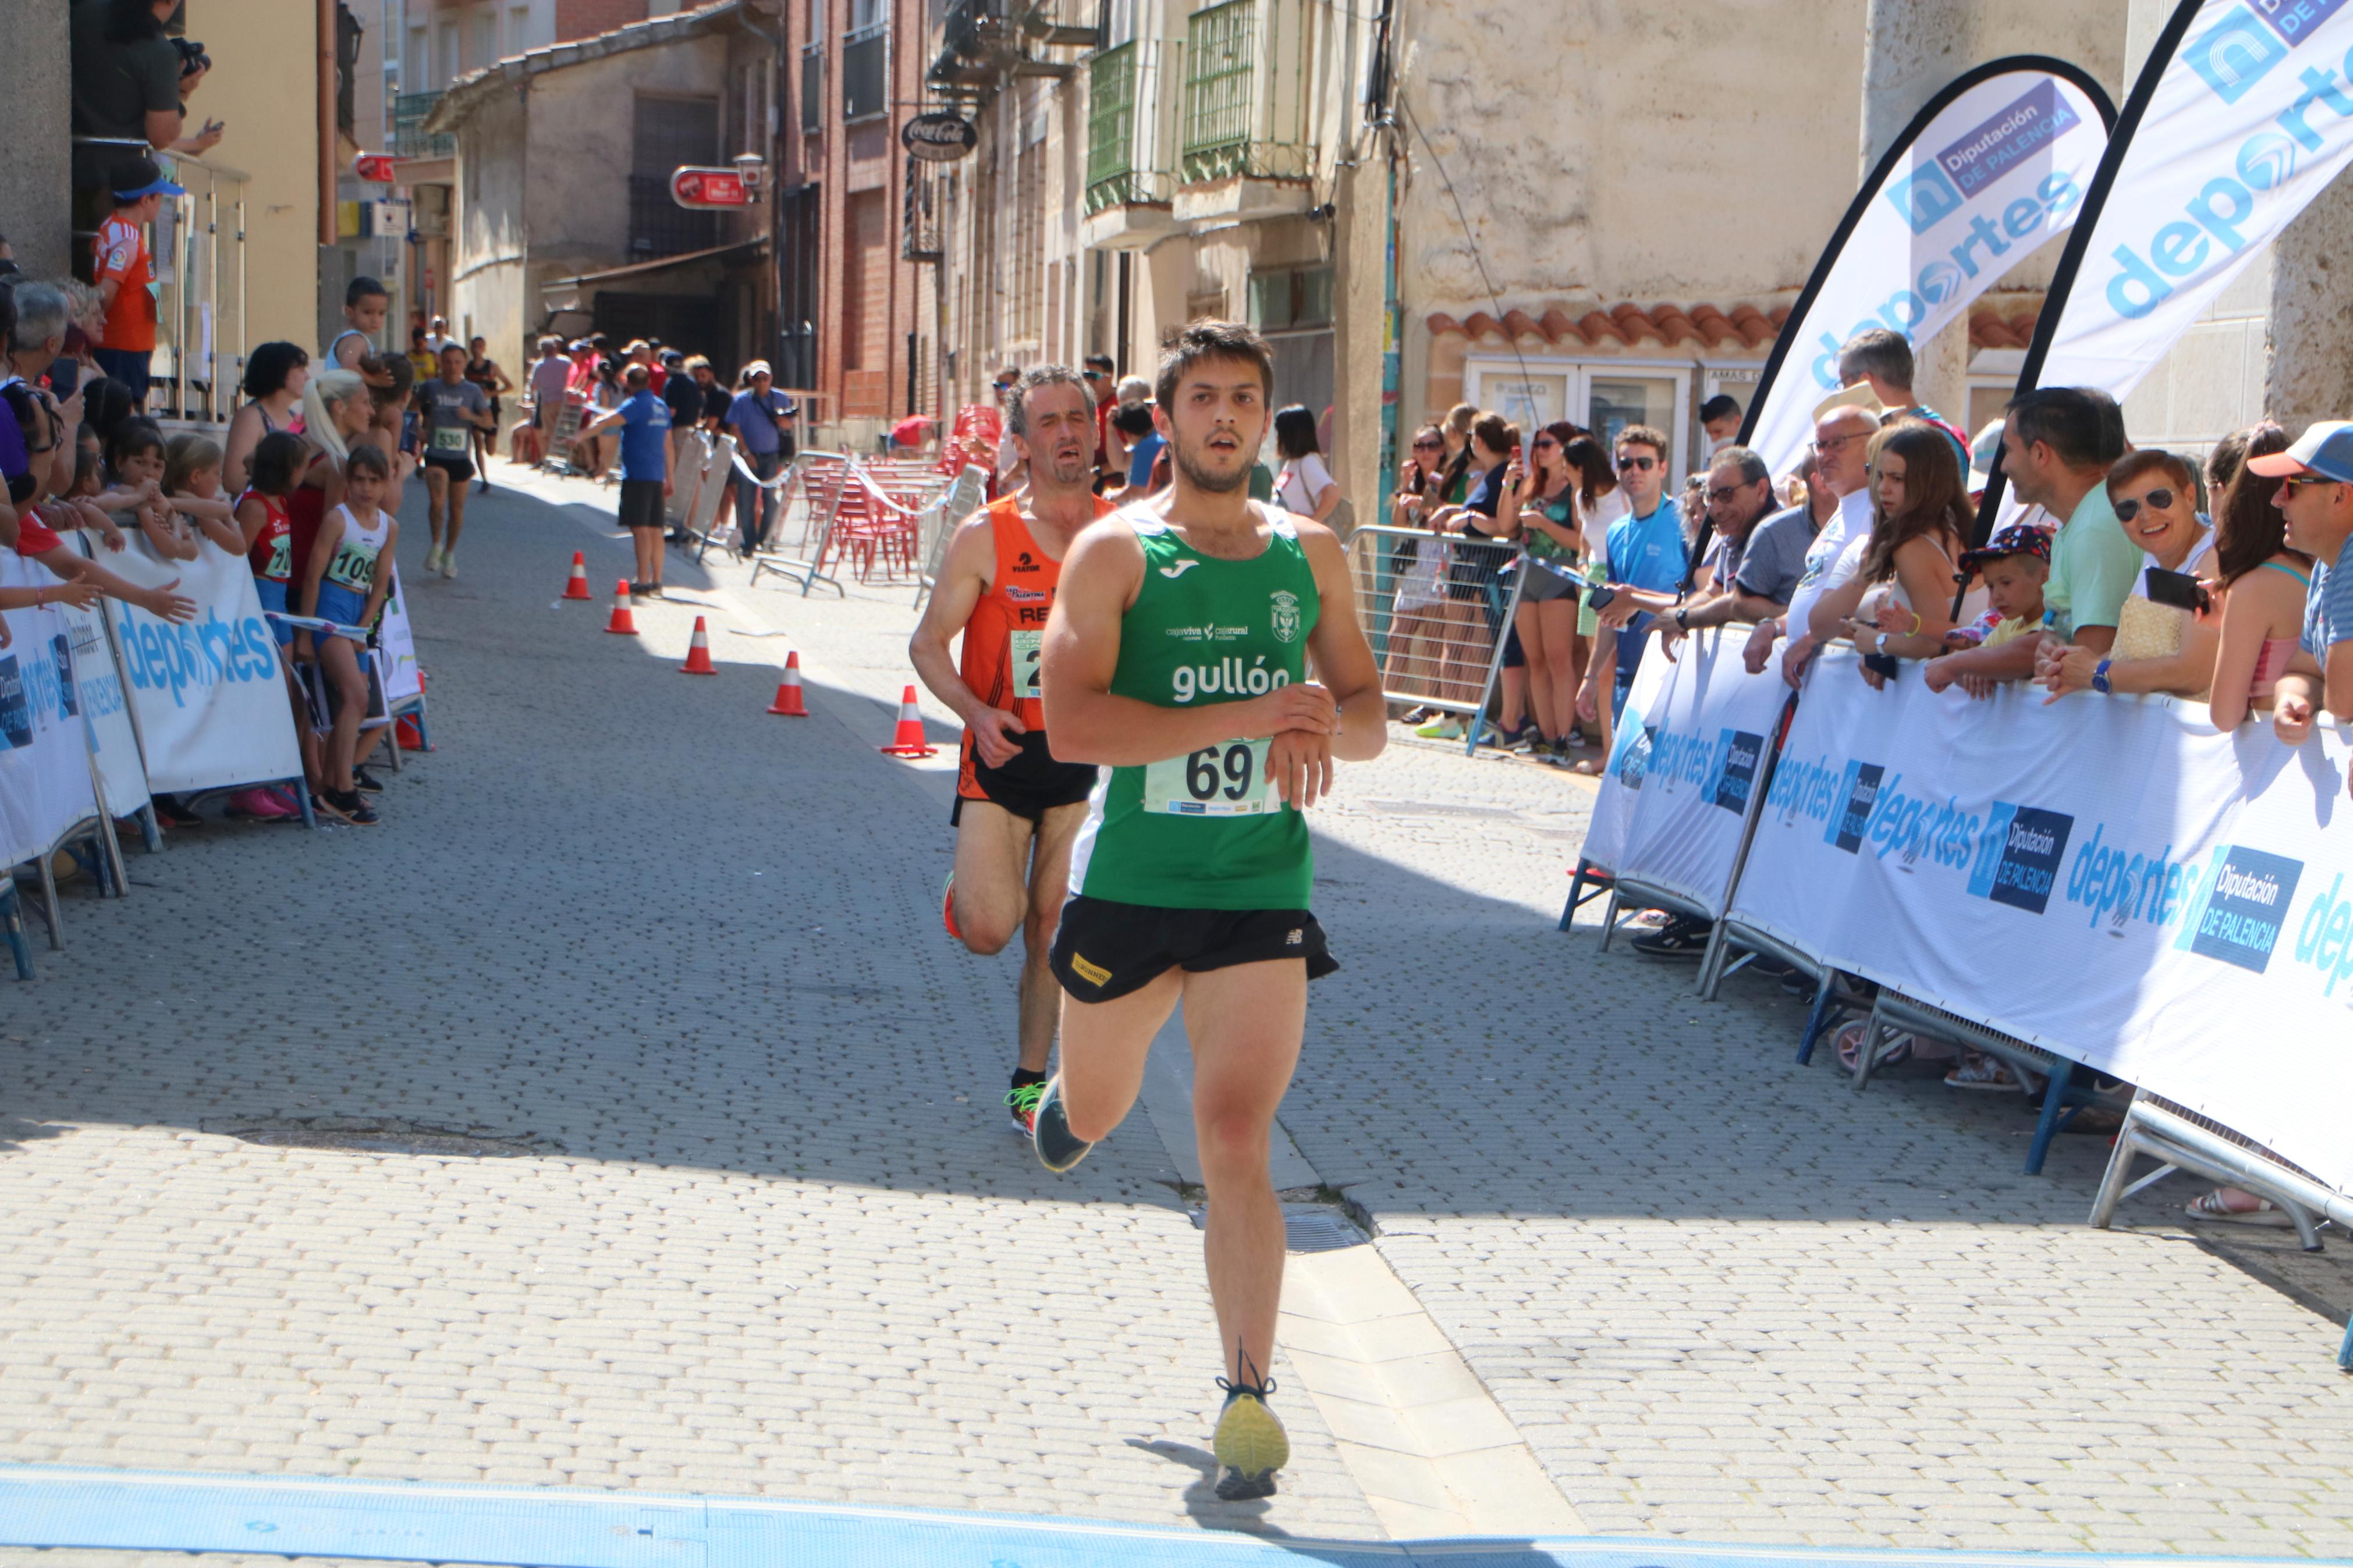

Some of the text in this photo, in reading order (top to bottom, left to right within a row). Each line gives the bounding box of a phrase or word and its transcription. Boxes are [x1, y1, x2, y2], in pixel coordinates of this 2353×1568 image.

[2279, 1, 2316, 35] DE
[1946, 105, 2038, 172] Diputación
[1959, 108, 2072, 189] DE PALENCIA
[439, 433, 462, 447] 530
[338, 552, 376, 584] 109
[1020, 607, 1049, 624] RE
[1166, 626, 1248, 638] cajaviva cajarural
[1026, 650, 1041, 687] 2
[1173, 656, 1290, 703] gullón
[1186, 744, 1253, 801] 69
[1768, 742, 1839, 822] deportes
[1864, 773, 1979, 870] deportes
[2008, 822, 2054, 855] Diputación
[2067, 823, 2199, 928] deportes
[2216, 864, 2279, 906] Diputación
[2295, 873, 2353, 997] dep
[1997, 861, 2053, 897] DE PALENCIA
[2200, 908, 2277, 954] DE PALENCIA
